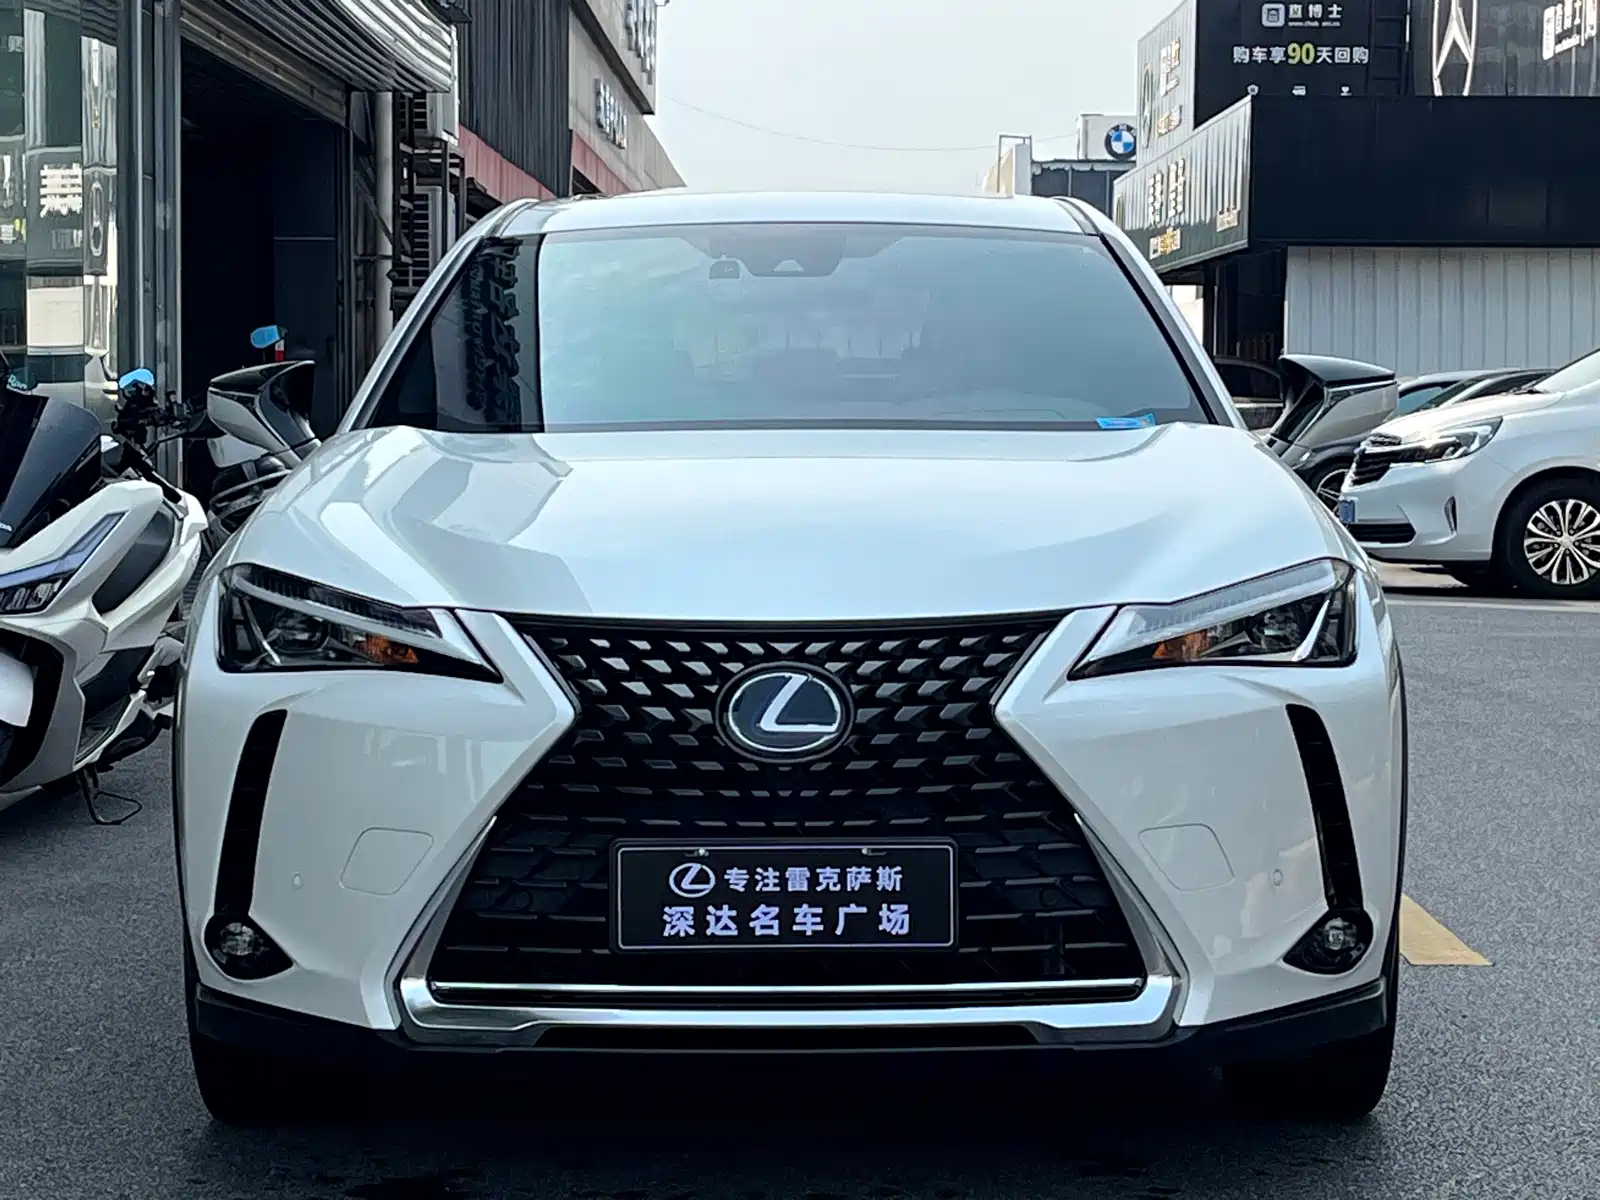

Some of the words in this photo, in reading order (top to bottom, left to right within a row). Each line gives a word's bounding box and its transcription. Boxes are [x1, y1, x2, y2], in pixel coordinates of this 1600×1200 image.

[1233, 43, 1369, 64] 购车享90天回购
[724, 866, 903, 892] 专注雷克萨斯
[663, 903, 910, 937] 深达名车广场
